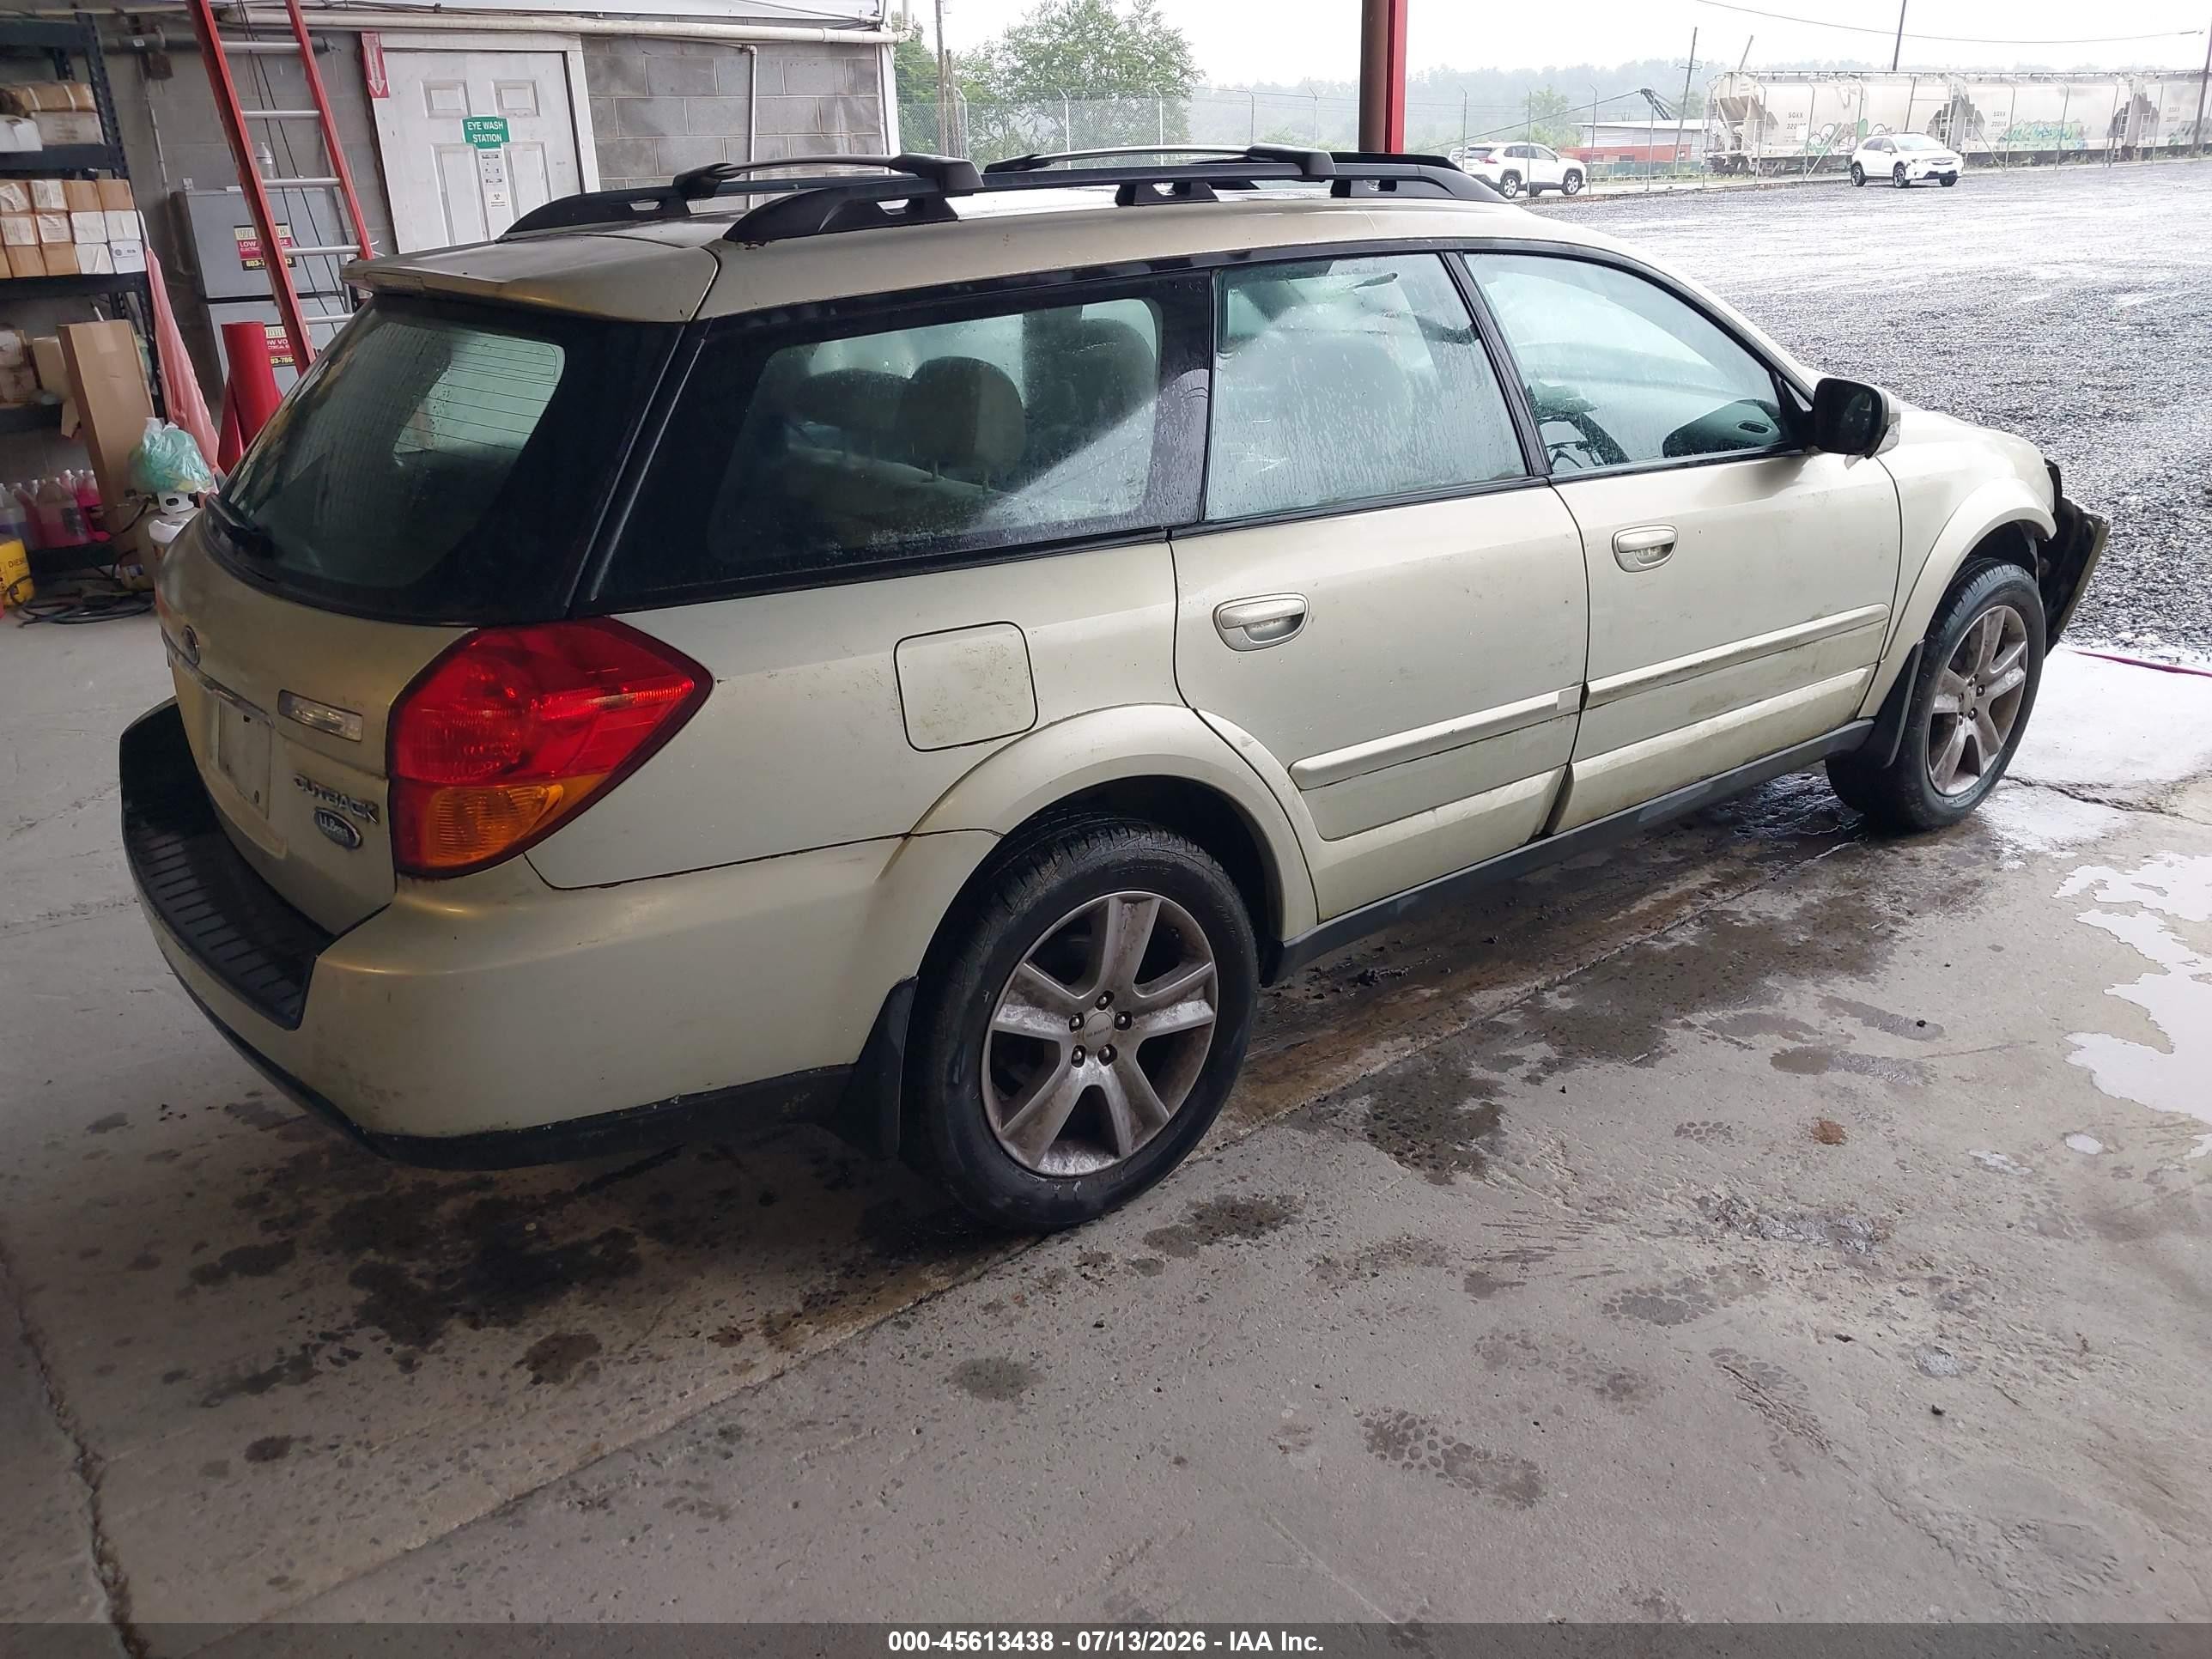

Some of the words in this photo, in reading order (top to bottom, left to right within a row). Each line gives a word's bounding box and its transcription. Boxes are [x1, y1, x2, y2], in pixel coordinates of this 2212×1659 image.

[467, 122, 483, 131] EYE
[483, 120, 504, 131] WASH
[472, 133, 502, 143] STATION
